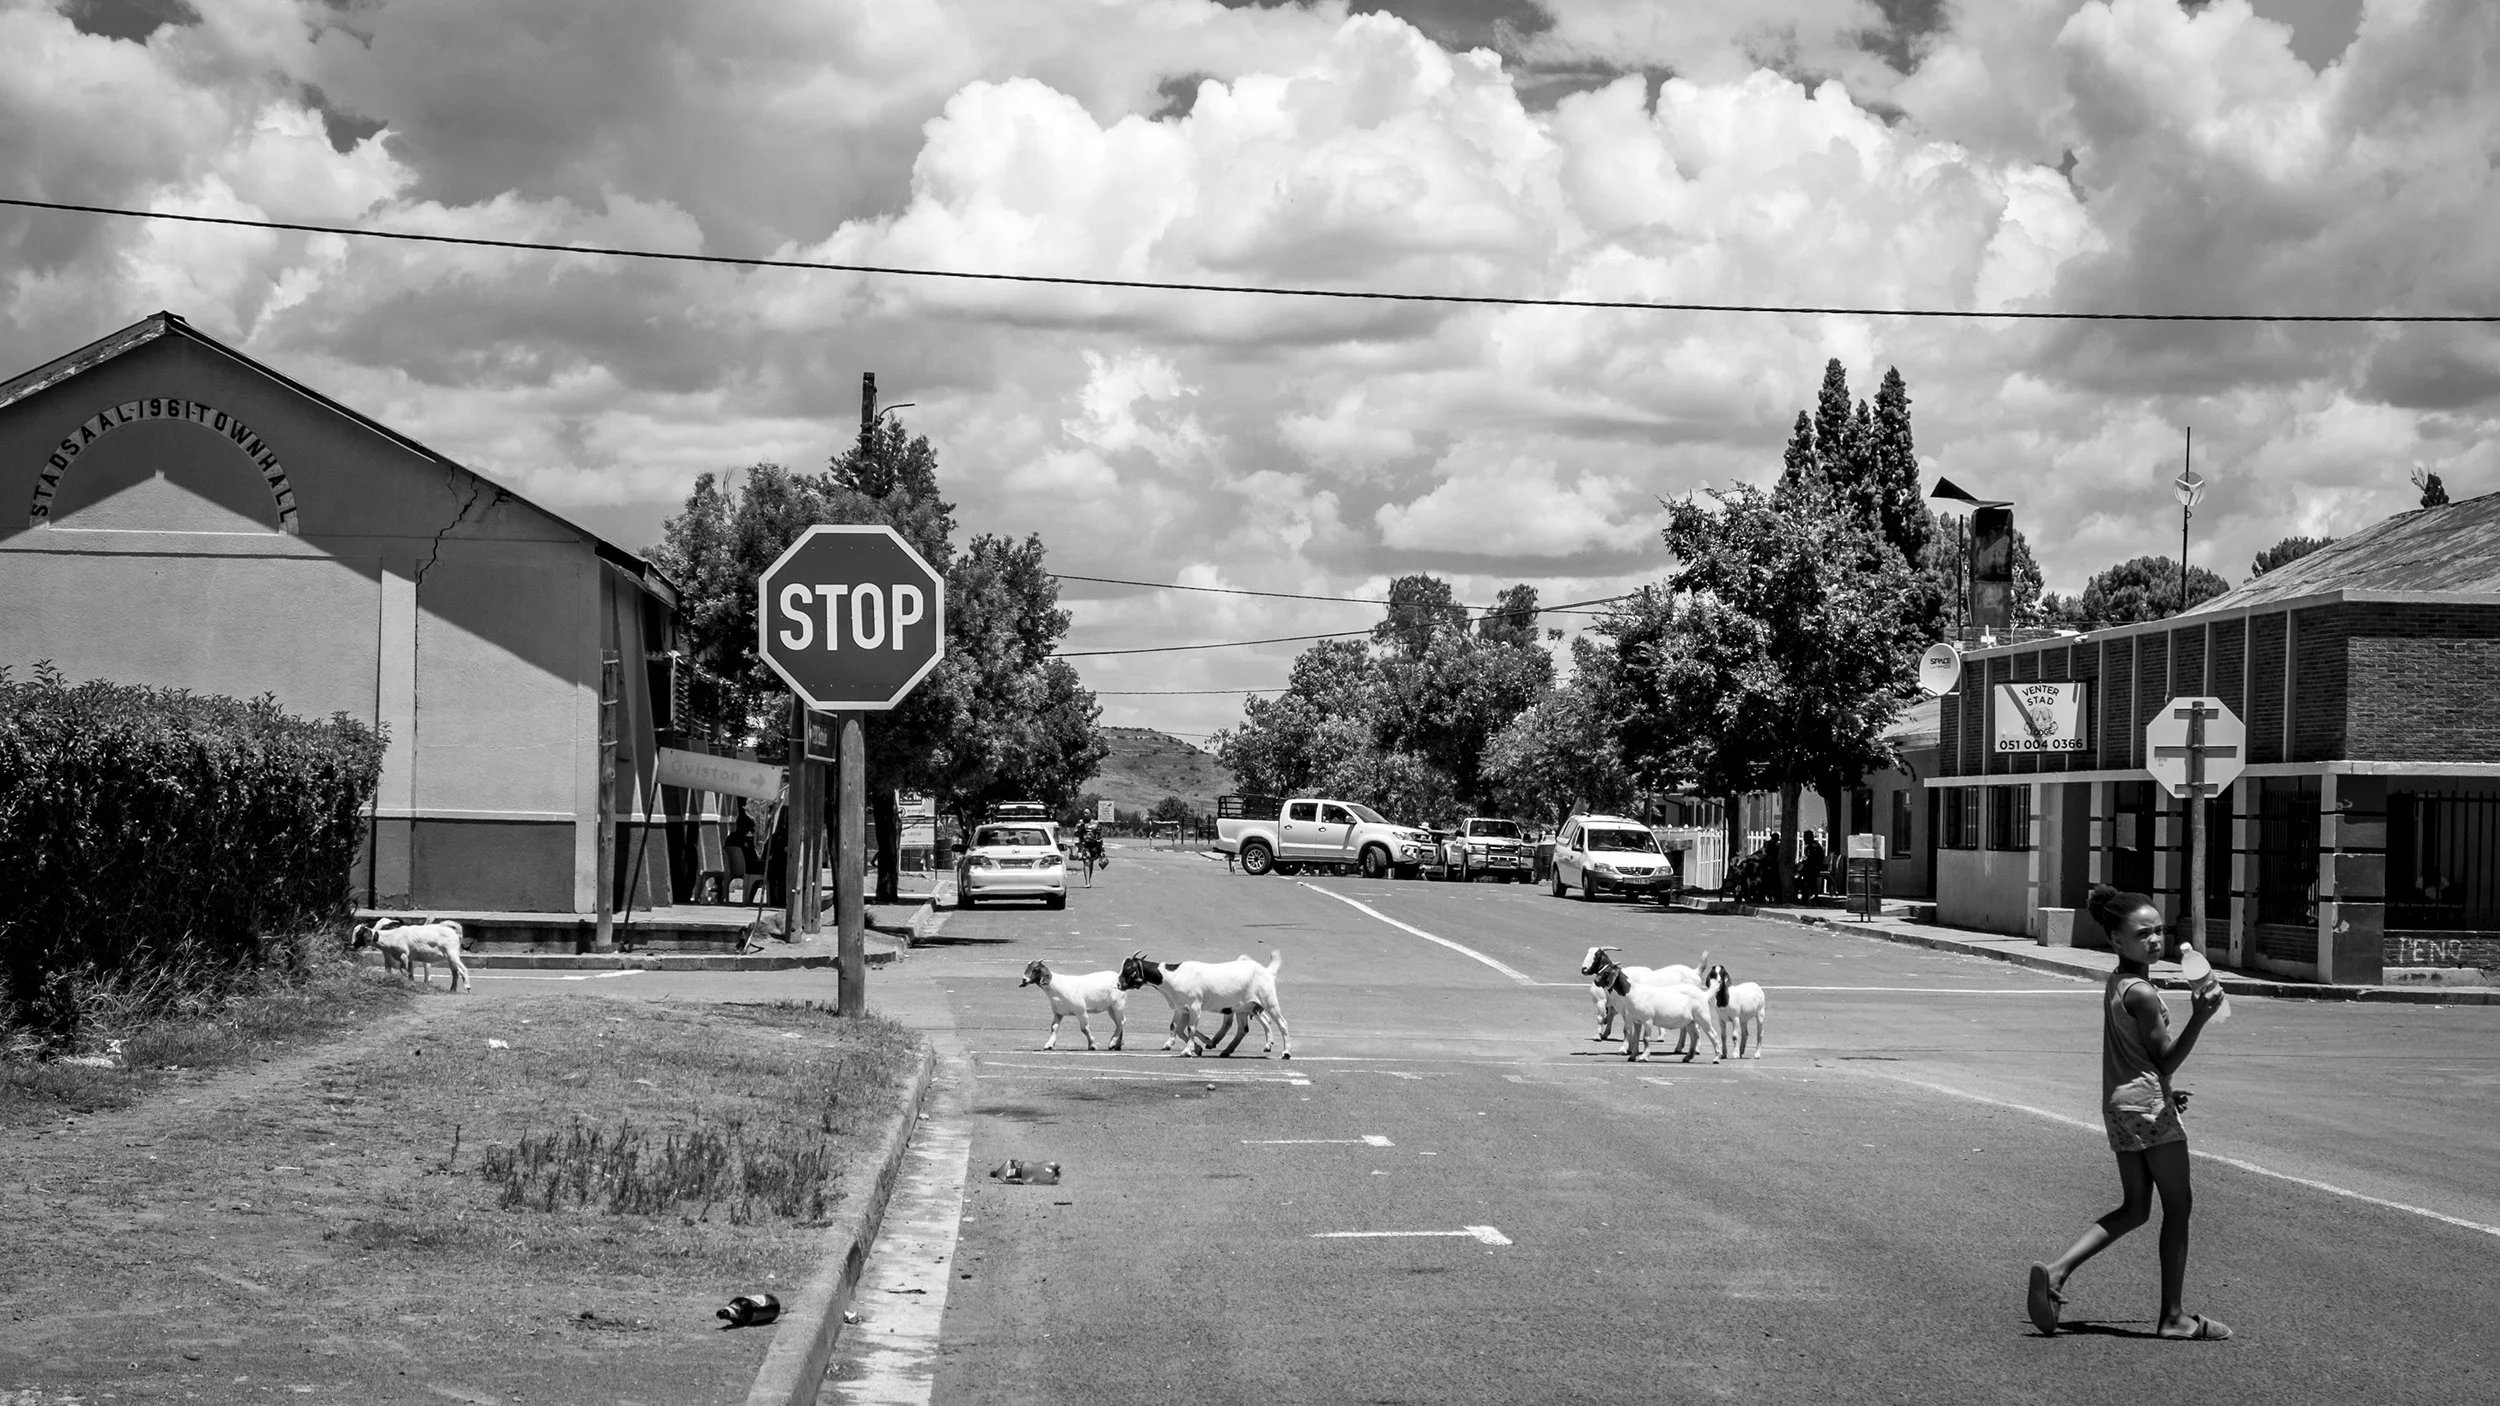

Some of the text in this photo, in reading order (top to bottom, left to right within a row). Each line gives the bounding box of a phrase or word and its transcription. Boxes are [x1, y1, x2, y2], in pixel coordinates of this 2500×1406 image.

[780, 582, 924, 651] STOP
[2022, 685, 2060, 696] VENTER
[2027, 696, 2054, 706] STAD
[2000, 739, 2083, 750] 051 004 0366
[672, 760, 740, 782] Oviston
